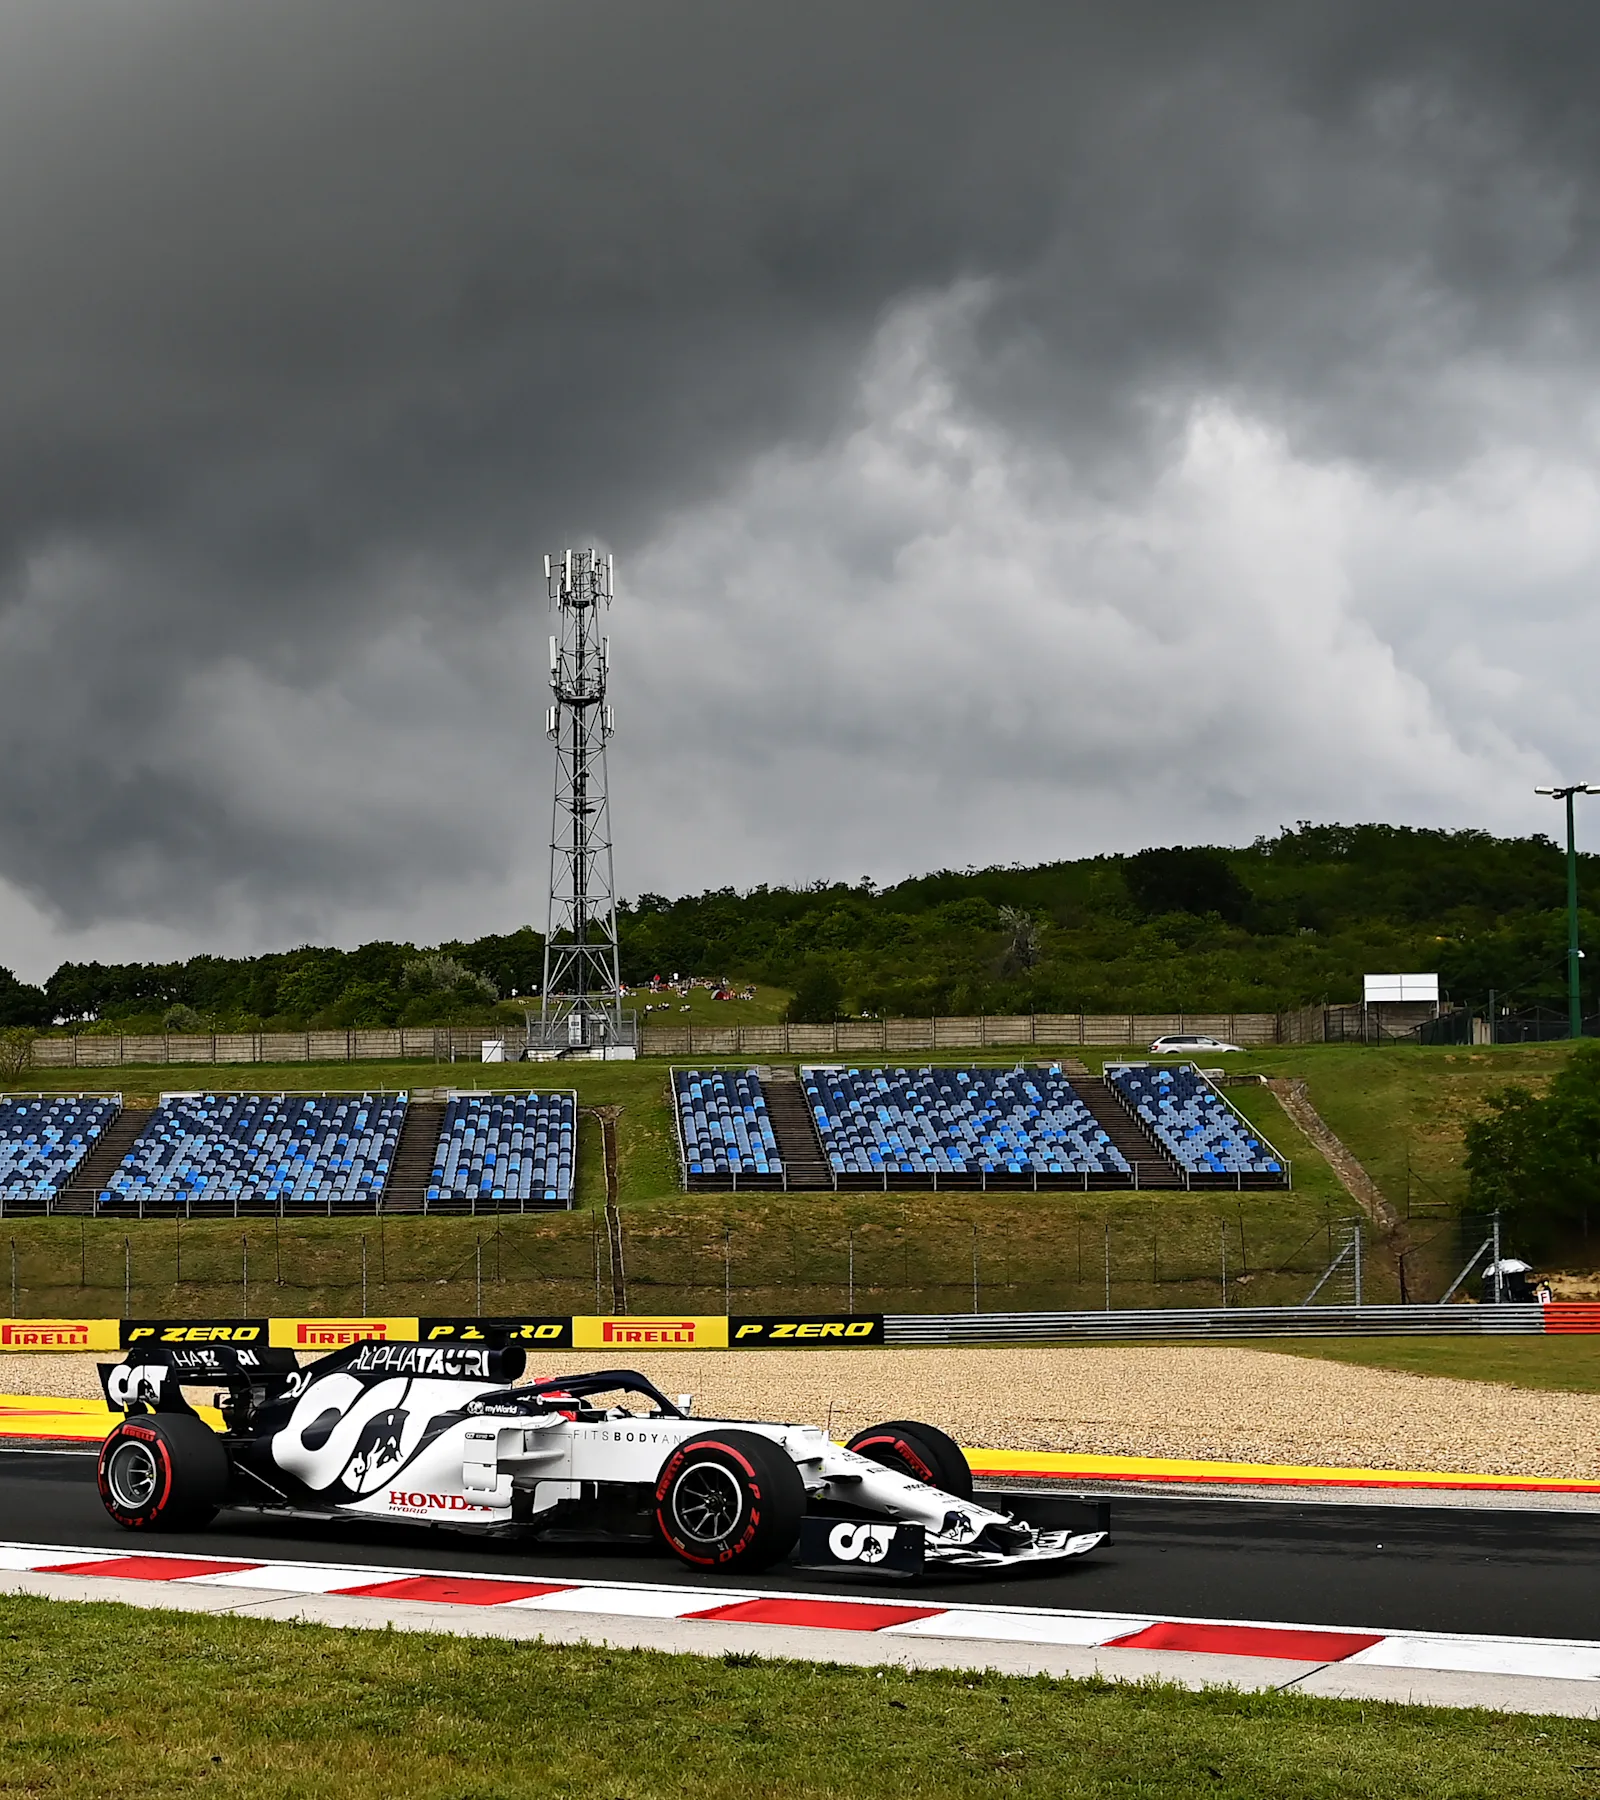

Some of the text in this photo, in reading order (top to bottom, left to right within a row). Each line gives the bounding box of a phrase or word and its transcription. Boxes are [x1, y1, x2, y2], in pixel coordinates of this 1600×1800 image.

[1, 1324, 90, 1345] PIRELLI
[128, 1327, 261, 1342] P ZERO
[428, 1324, 564, 1340] P ZRO
[602, 1321, 697, 1343] PIRELLI
[735, 1322, 875, 1339] P ZERO
[347, 1345, 490, 1377] ALPHATAURI
[388, 1505, 428, 1514] HYBRID
[389, 1491, 493, 1511] HOND
